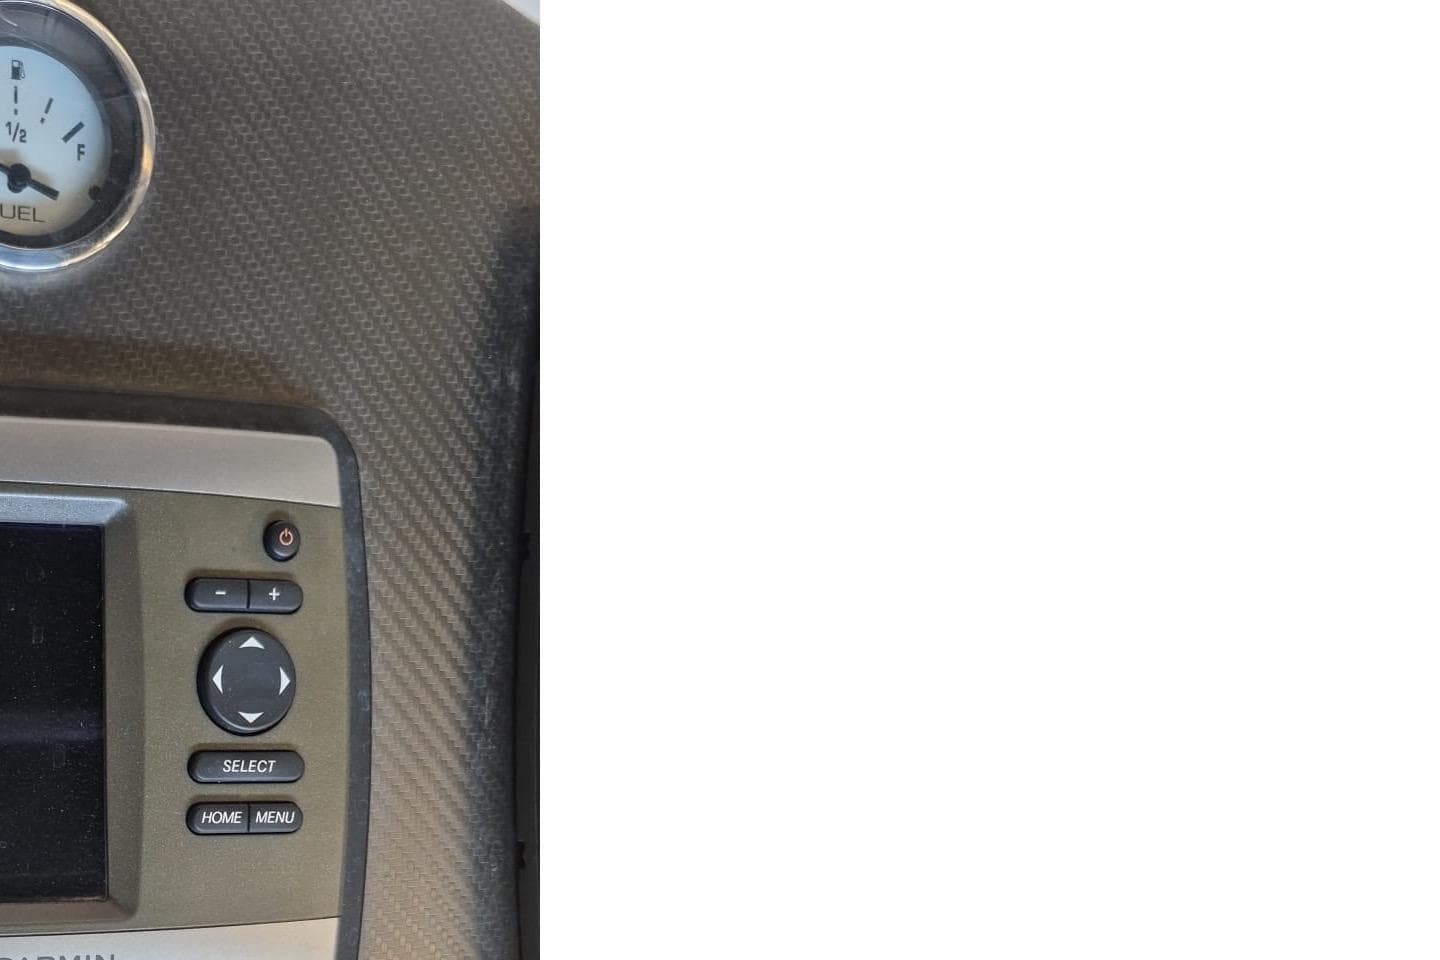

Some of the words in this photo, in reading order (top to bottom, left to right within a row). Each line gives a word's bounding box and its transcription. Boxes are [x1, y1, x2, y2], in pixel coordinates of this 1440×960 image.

[77, 143, 86, 161] F
[222, 759, 276, 773] SELECT
[201, 811, 242, 824] HOME
[255, 811, 295, 824] MENU
